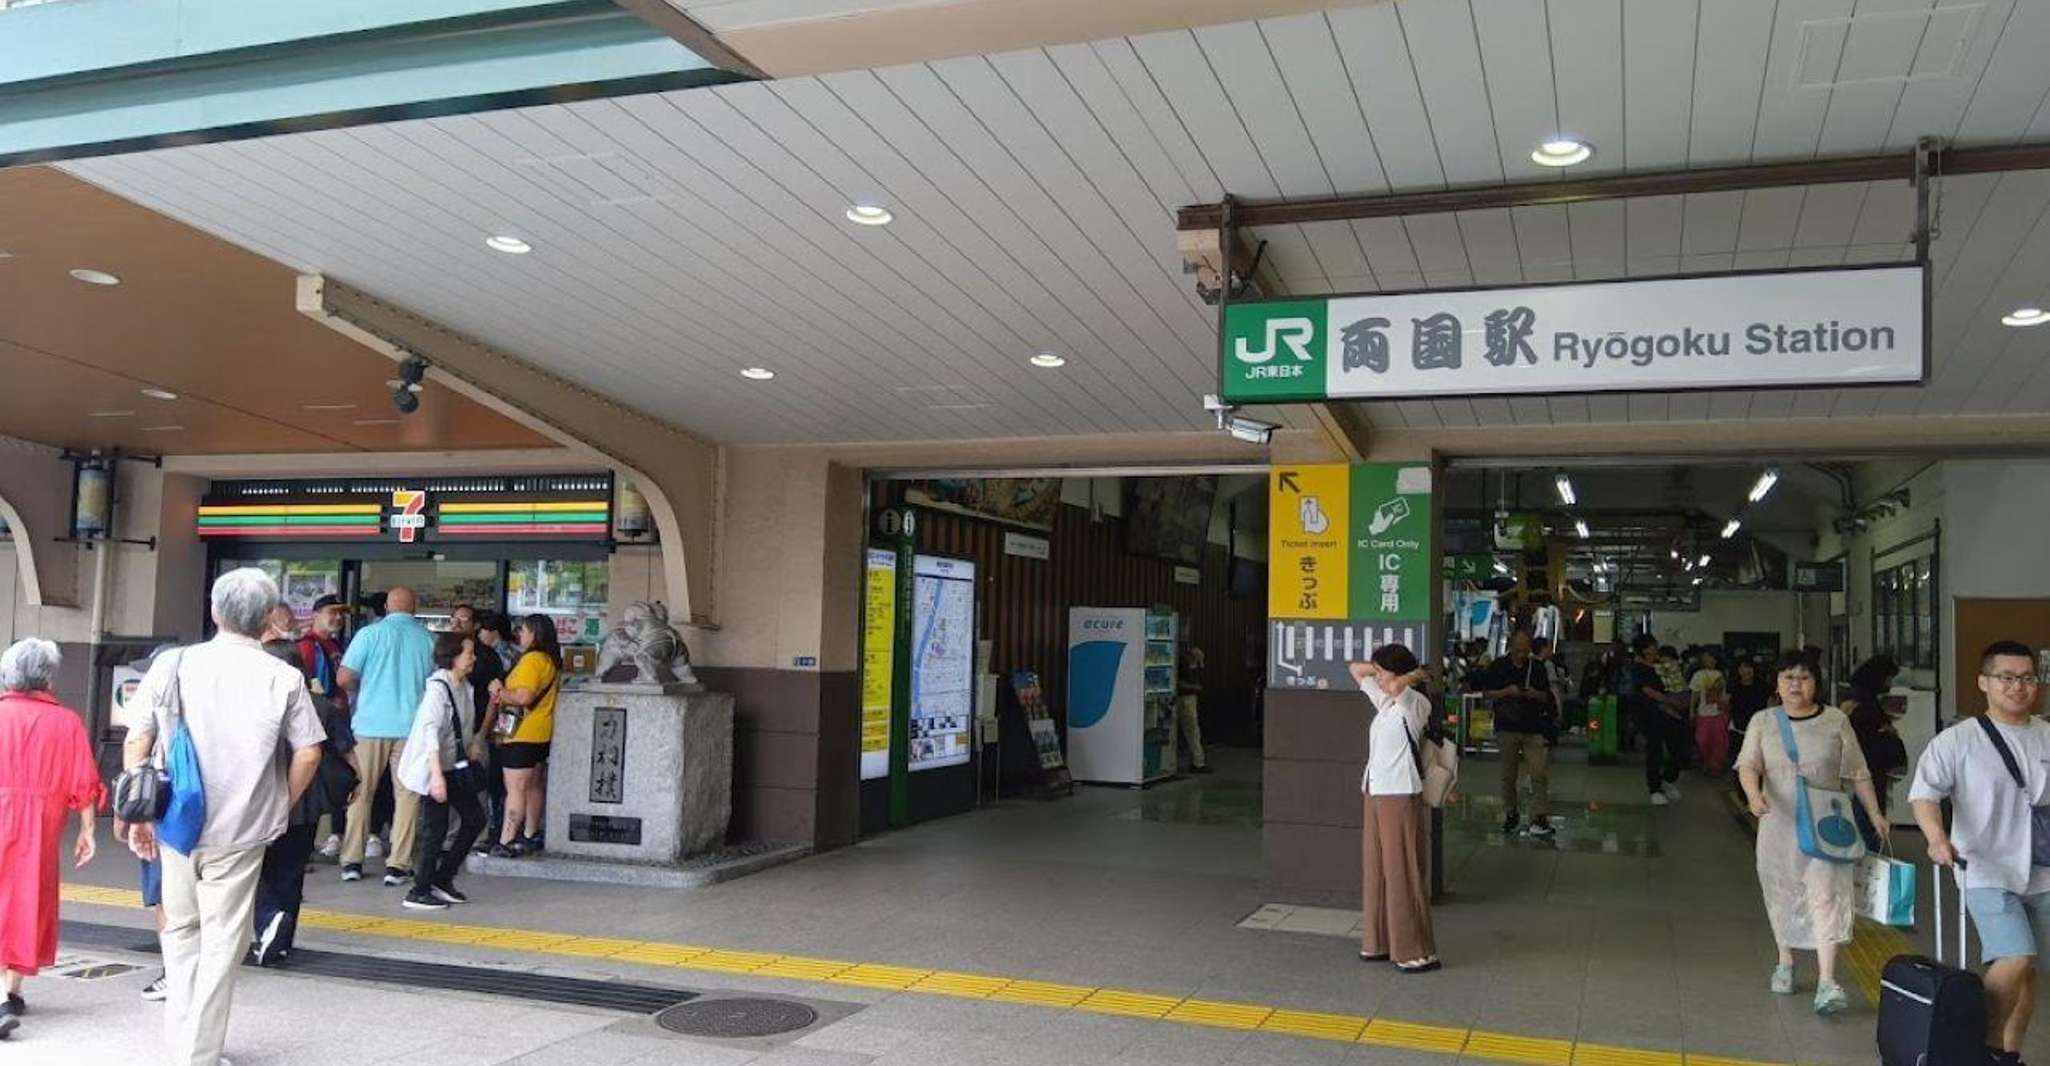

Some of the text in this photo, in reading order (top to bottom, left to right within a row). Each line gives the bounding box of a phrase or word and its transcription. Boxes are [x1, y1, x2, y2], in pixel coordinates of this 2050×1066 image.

[1235, 318, 1314, 363] JR
[1340, 306, 1538, 374] 両国駅
[1553, 321, 1894, 368] Ryōgoku Station
[1245, 365, 1304, 379] JR東日本
[393, 490, 425, 542] 7
[1281, 540, 1308, 548] Ticket
[1358, 540, 1419, 549] IC Card Only
[1299, 556, 1317, 609] きっぷ
[1379, 554, 1401, 612] IC専用
[1083, 619, 1124, 630] acure
